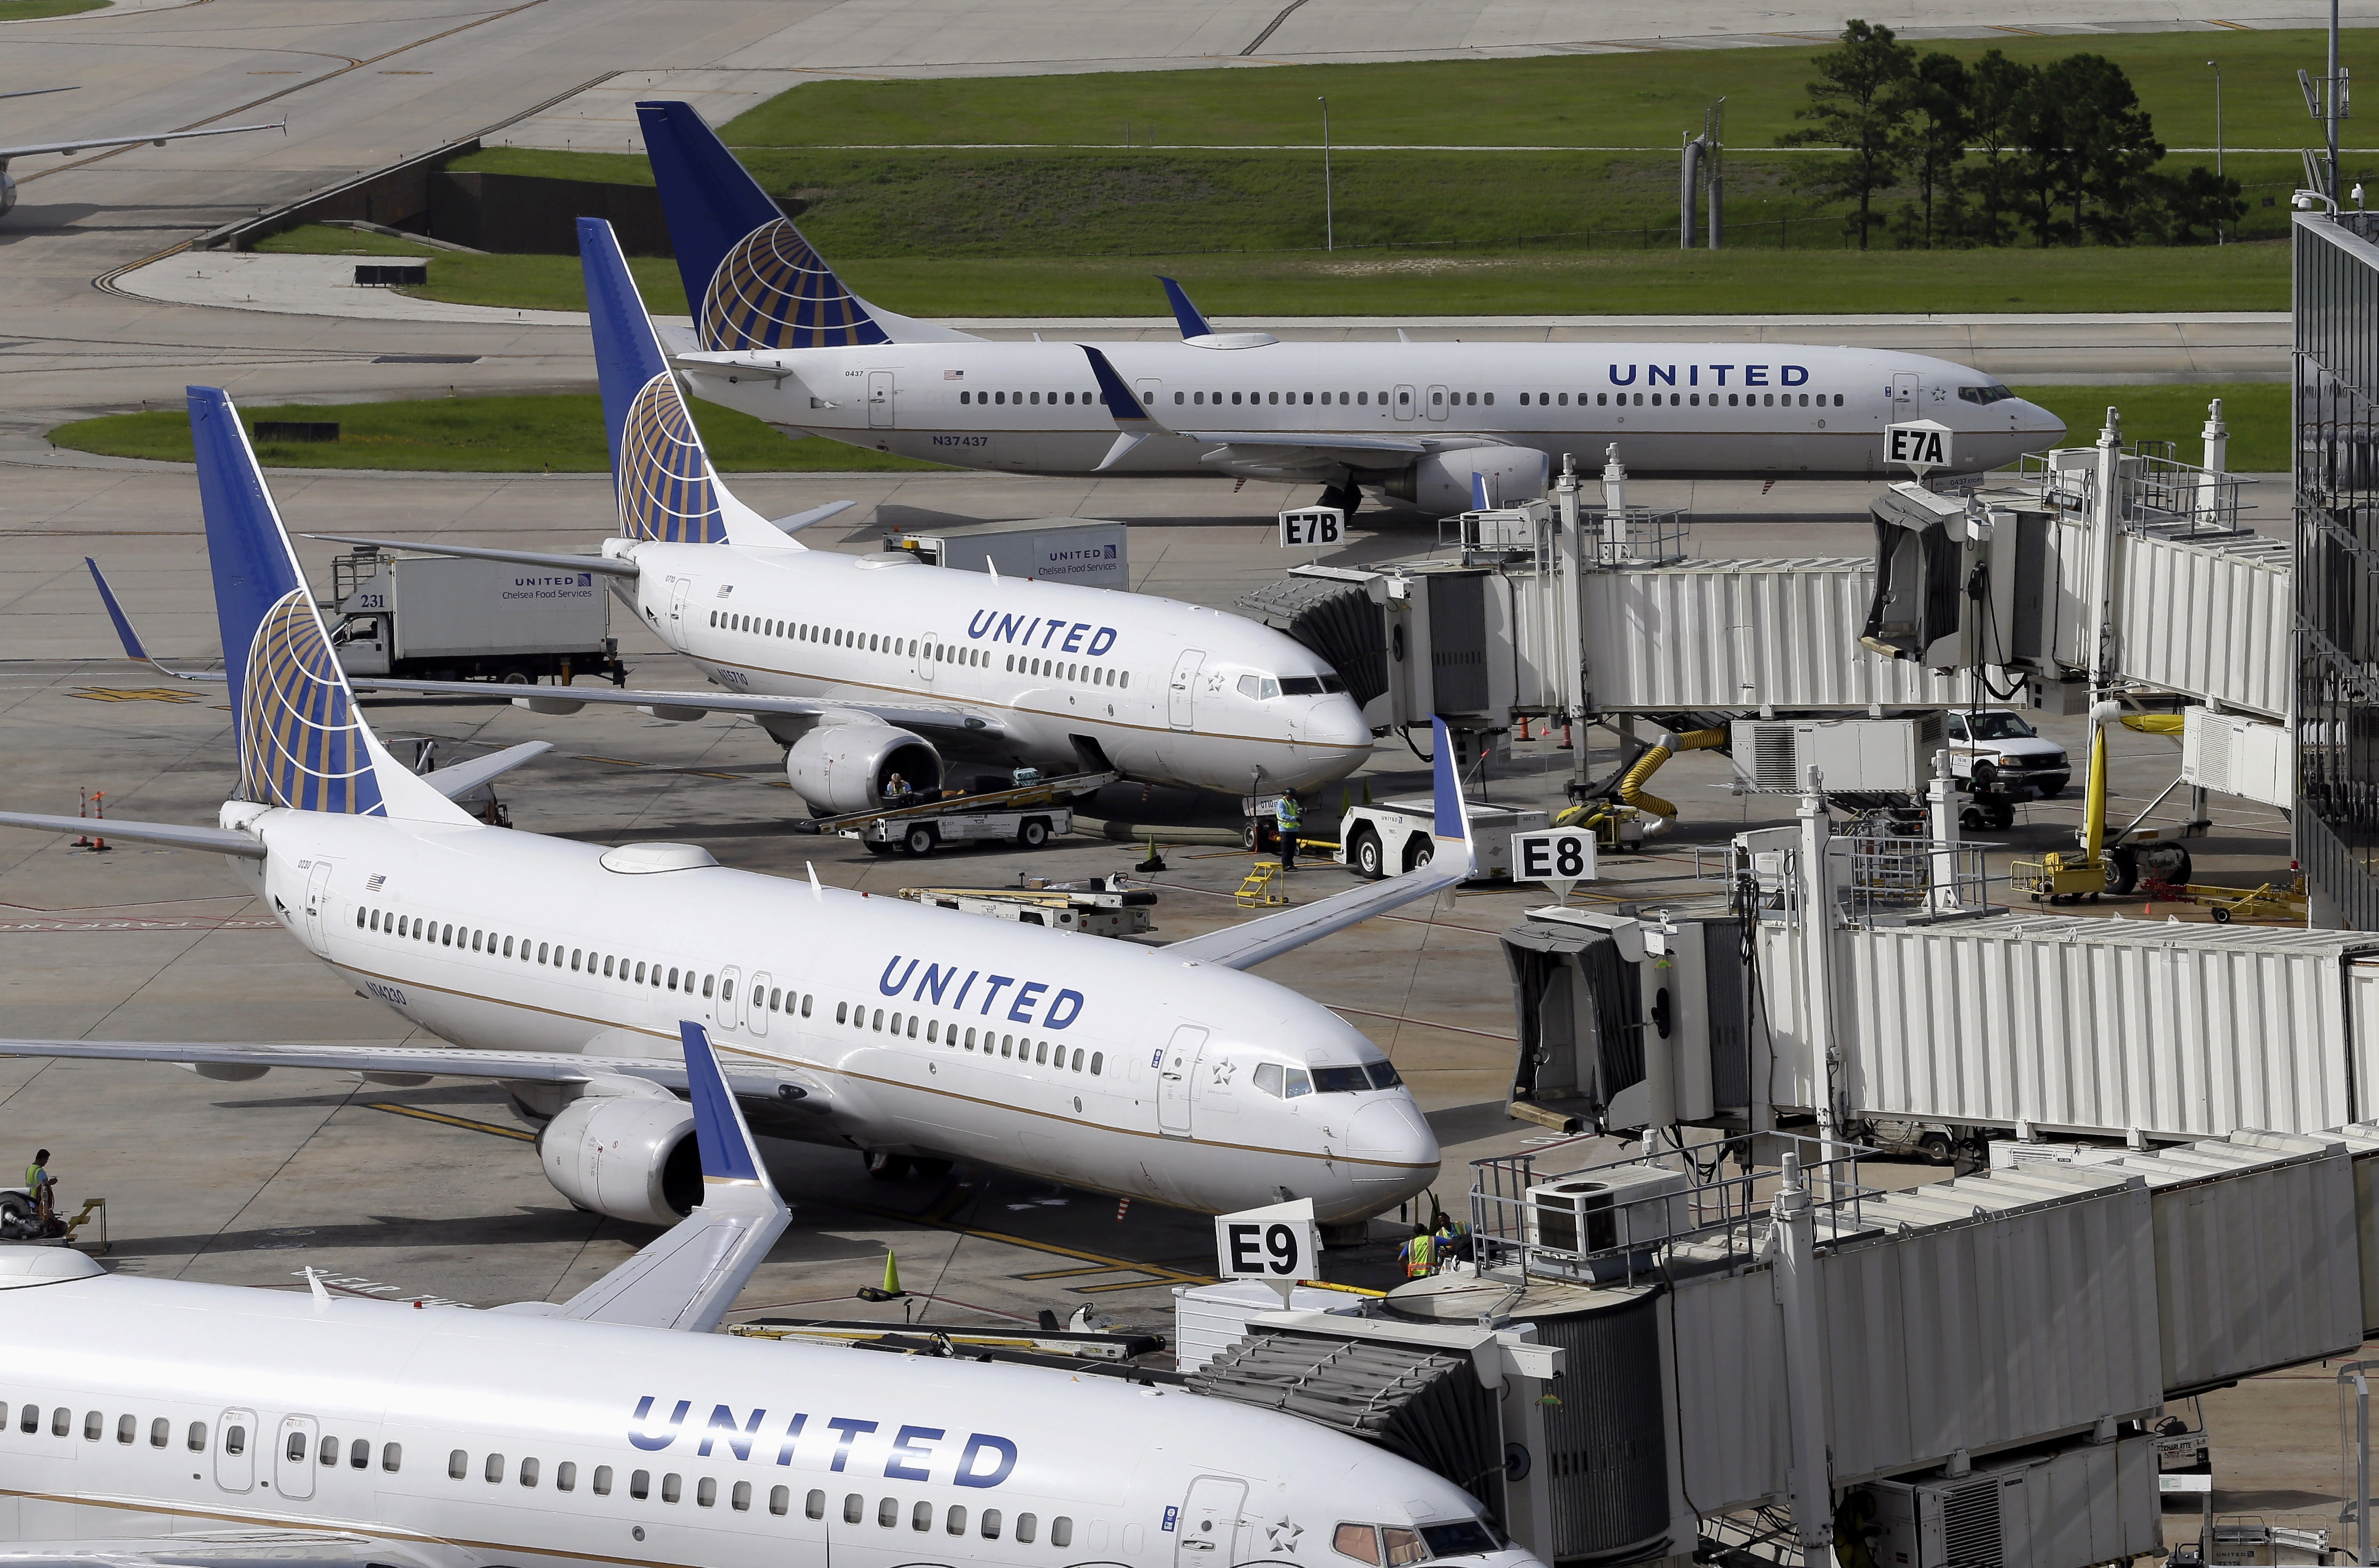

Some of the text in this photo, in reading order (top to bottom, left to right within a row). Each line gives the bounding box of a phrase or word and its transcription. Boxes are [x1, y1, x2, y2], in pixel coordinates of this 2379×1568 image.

[1609, 364, 1809, 386] UNITED
[933, 436, 988, 447] N37437
[1891, 430, 1944, 464] E7A
[1949, 477, 1967, 486] 0437
[1286, 512, 1338, 544] E7B
[1050, 549, 1101, 561] UNITED
[1038, 562, 1117, 576] Chelsea Food Services
[515, 577, 574, 586] UNITED
[361, 594, 385, 608] 231
[502, 589, 592, 599] Chelsea Food Services
[968, 609, 1117, 657] UNITED
[717, 668, 748, 686] N15710
[1260, 800, 1274, 809] 0710
[1523, 835, 1584, 877] E8
[298, 859, 312, 870] 0230
[365, 981, 407, 1005] N14230
[879, 955, 1084, 1030] UNITED
[1228, 1223, 1298, 1276] E9
[628, 1395, 1018, 1489] UNITED
[2163, 1442, 2192, 1451] CHARLATTE
